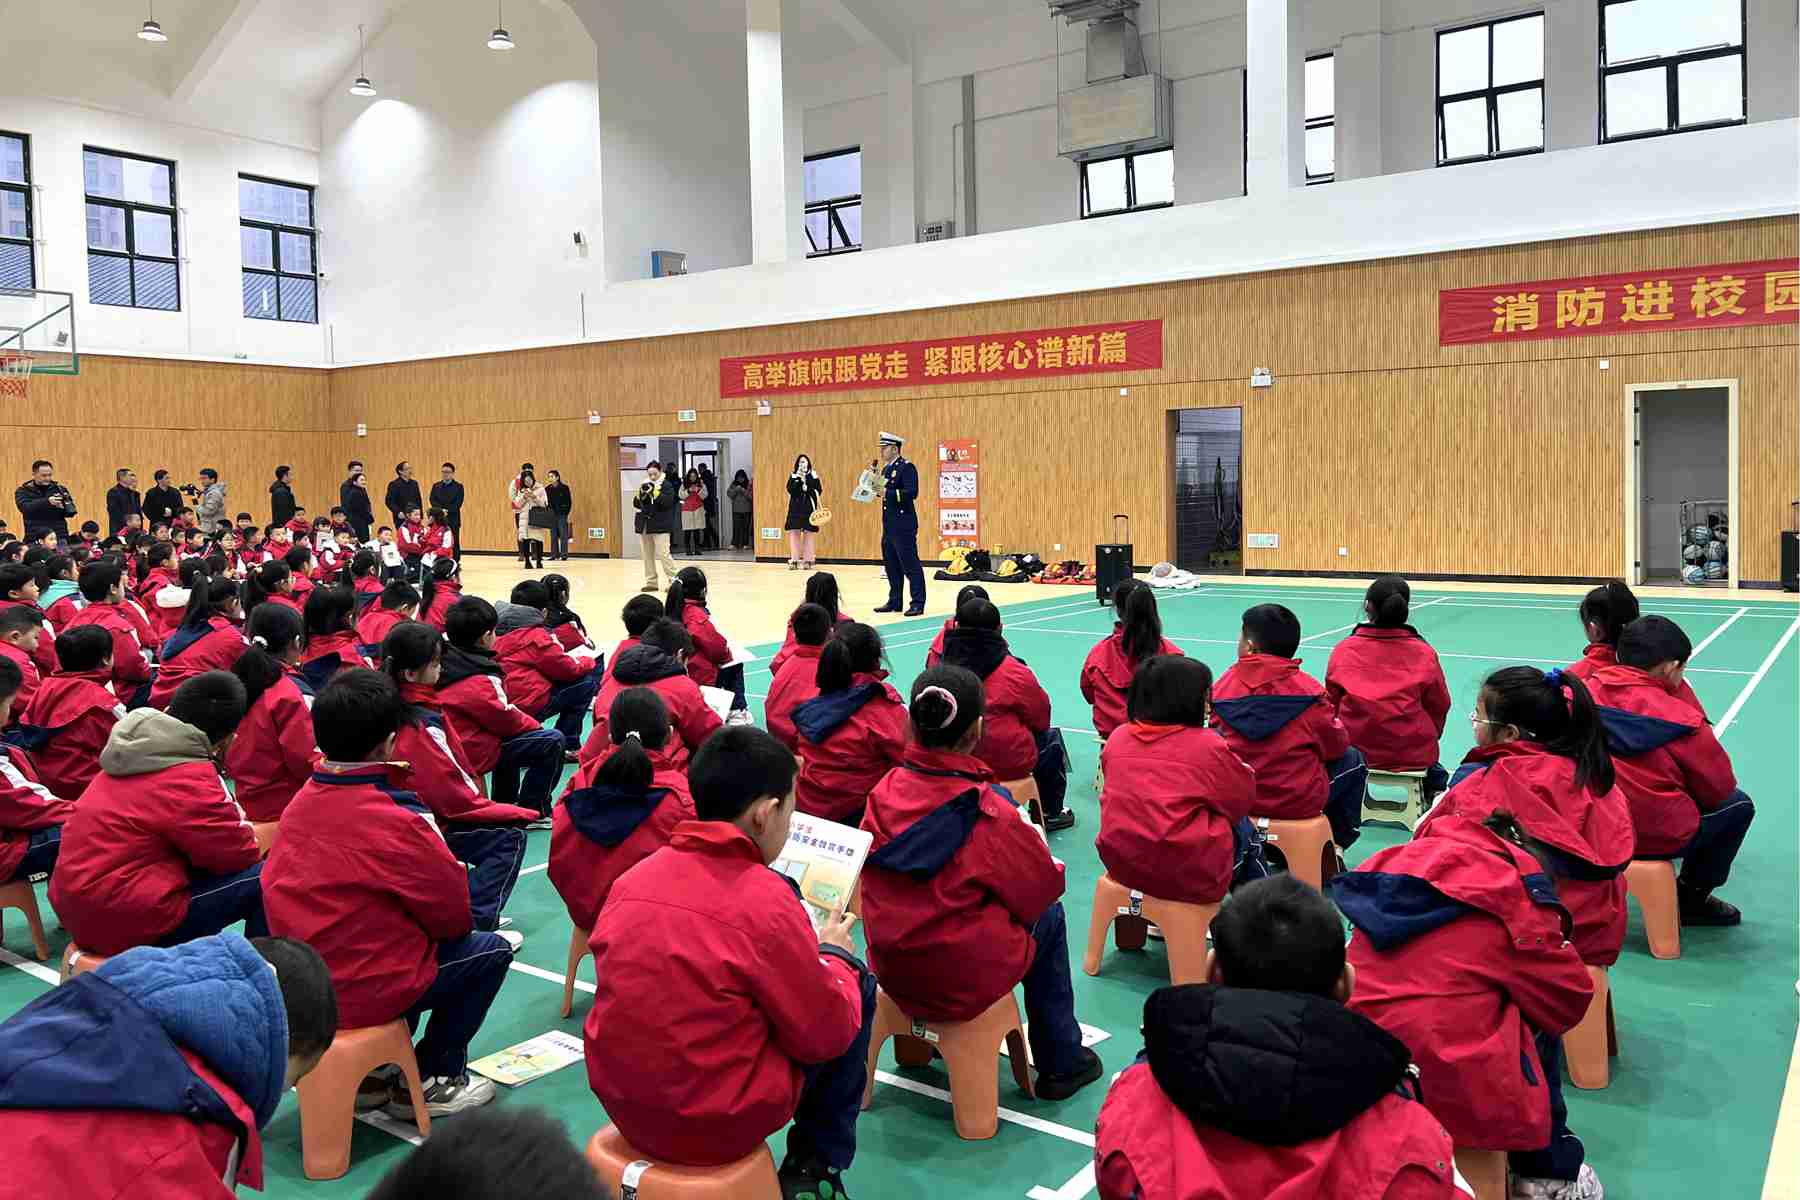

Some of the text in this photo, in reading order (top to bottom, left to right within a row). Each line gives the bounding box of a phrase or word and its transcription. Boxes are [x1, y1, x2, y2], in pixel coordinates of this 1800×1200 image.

[1491, 271, 1800, 333] 消防进校园
[742, 331, 1128, 390] 高举旗帜跟党走 紧跟核心谱新篇
